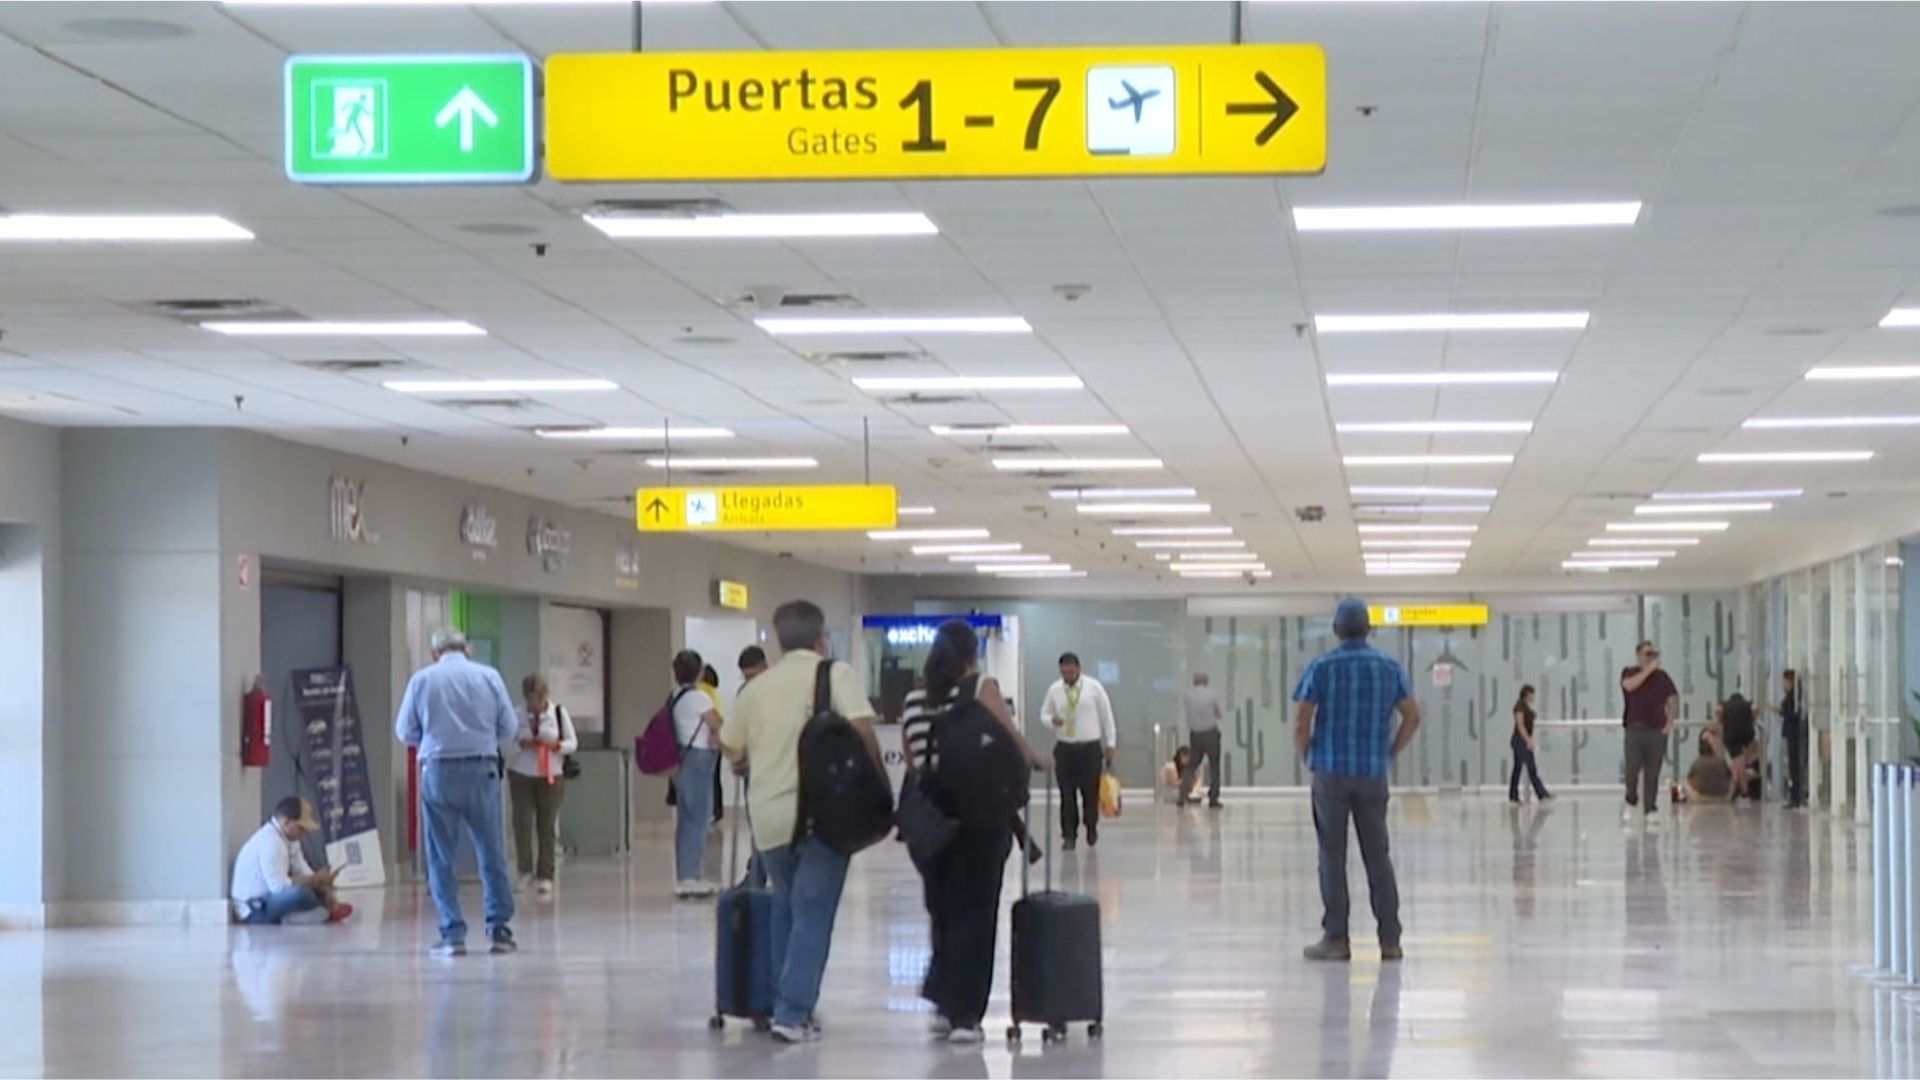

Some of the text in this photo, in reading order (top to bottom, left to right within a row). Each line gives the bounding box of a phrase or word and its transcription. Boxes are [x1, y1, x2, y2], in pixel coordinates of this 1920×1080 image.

[668, 68, 879, 112] Puertas
[898, 77, 1062, 153] 1 - 7
[787, 126, 878, 155] Gates
[722, 489, 804, 513] Llegadas
